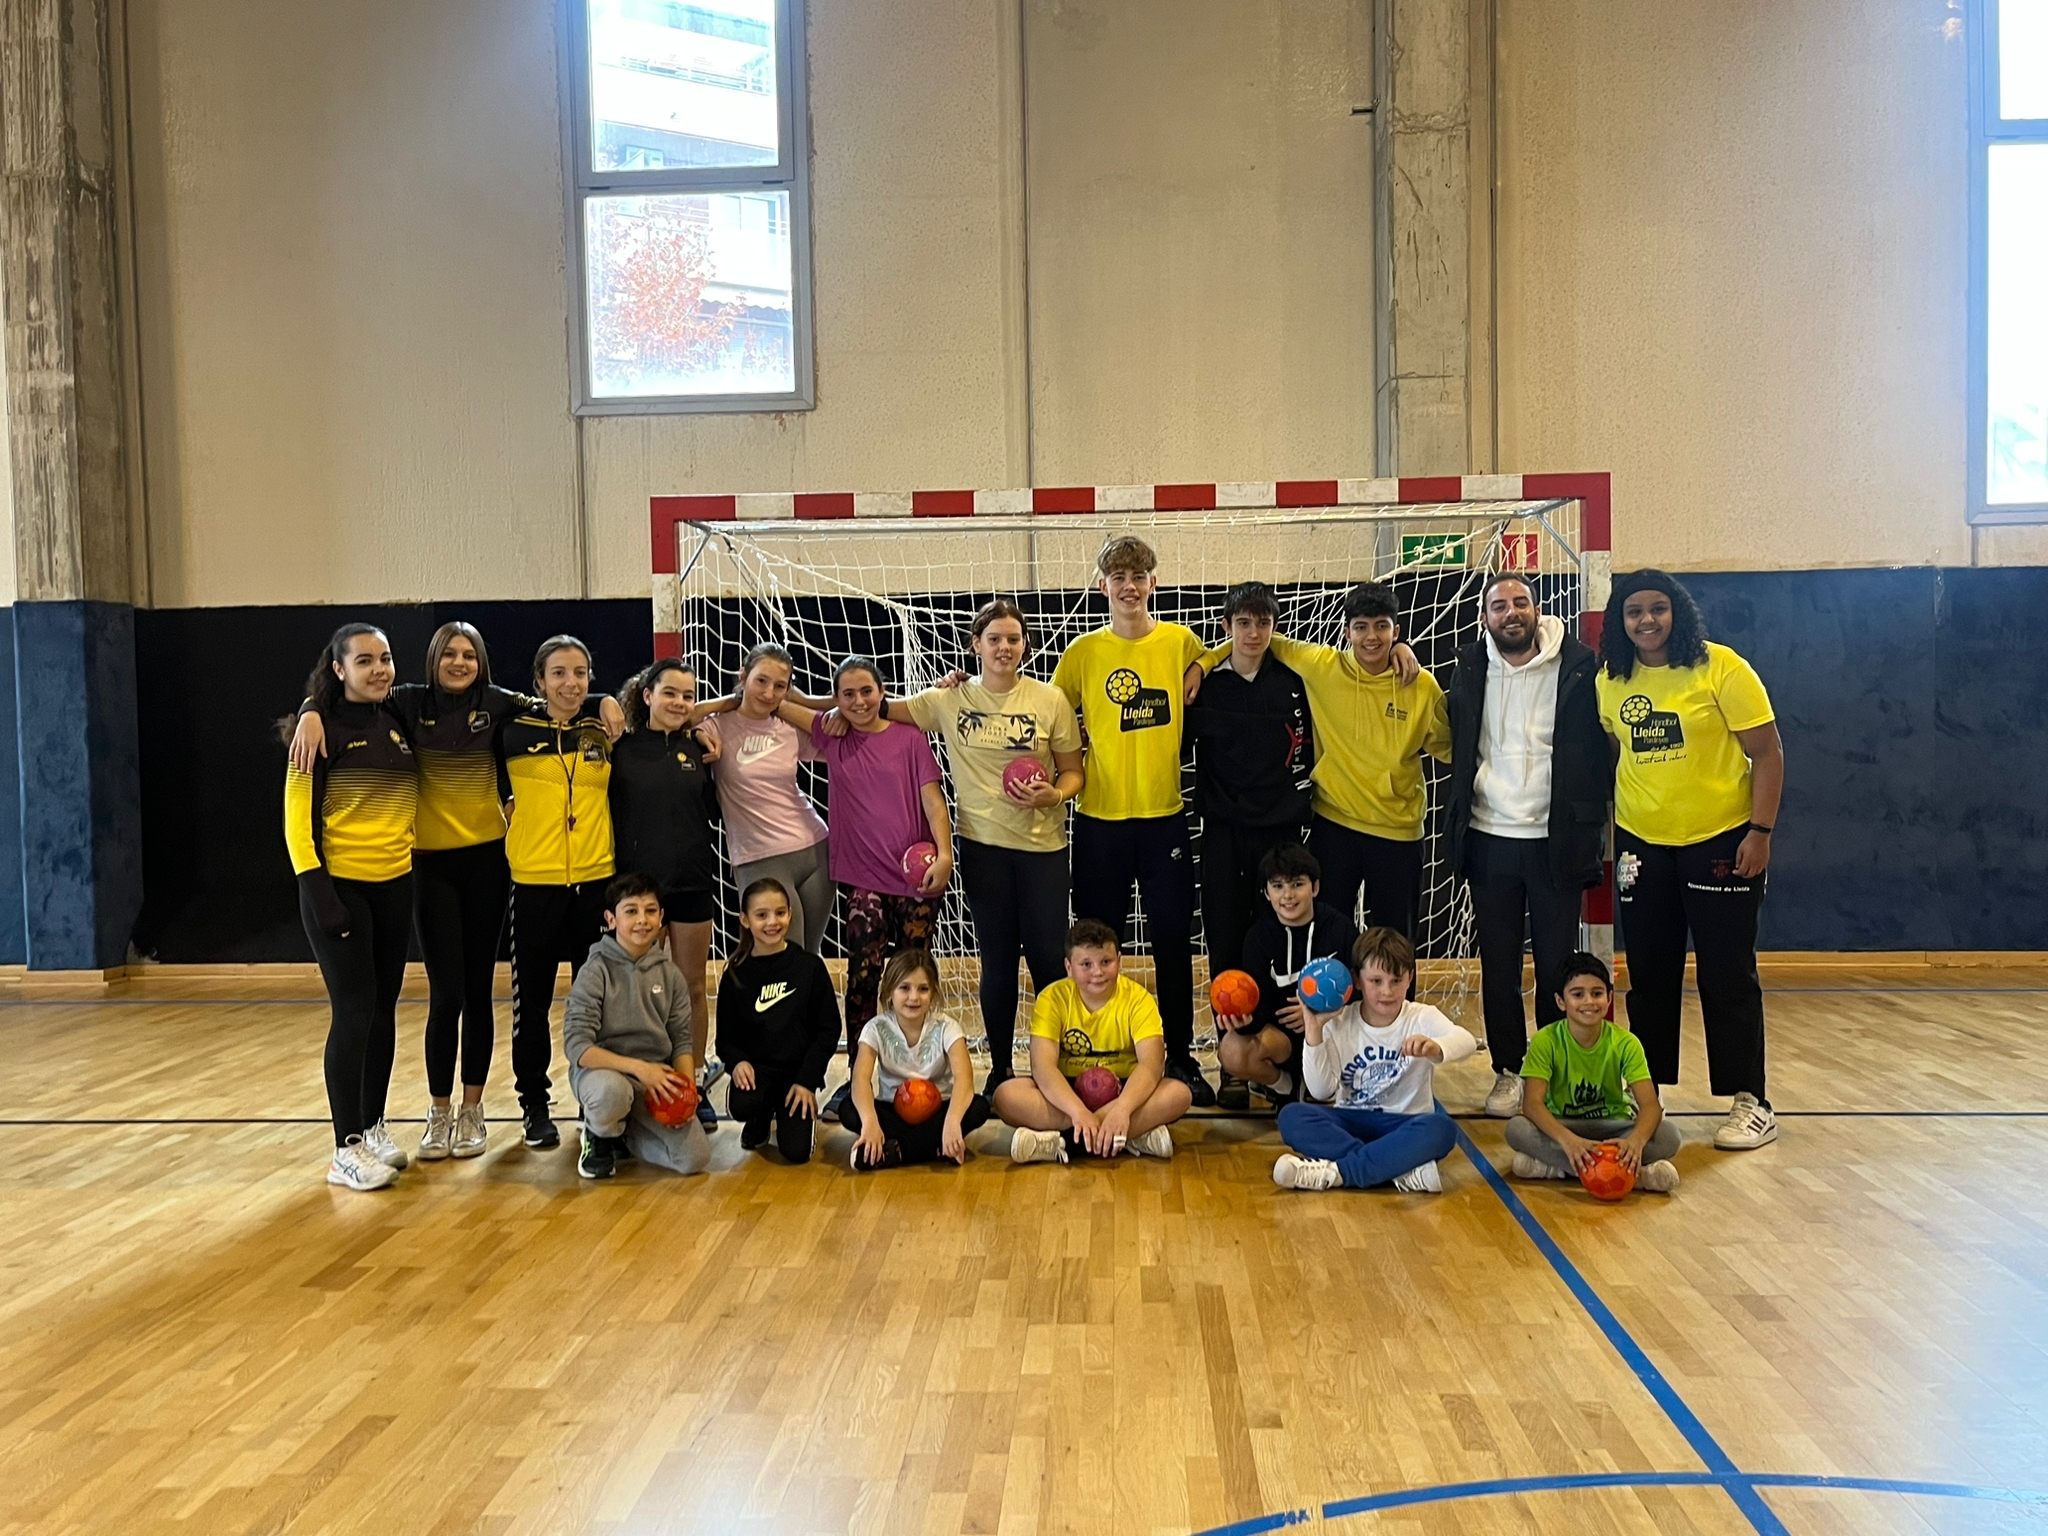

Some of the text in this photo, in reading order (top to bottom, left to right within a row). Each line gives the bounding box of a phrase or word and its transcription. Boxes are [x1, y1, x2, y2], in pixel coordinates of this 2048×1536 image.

[1123, 706, 1154, 720] Lleida
[1633, 726, 1665, 738] Lleida
[743, 735, 775, 751] NIKE
[761, 982, 787, 1001] NIKE
[1364, 1046, 1403, 1061] Clu
